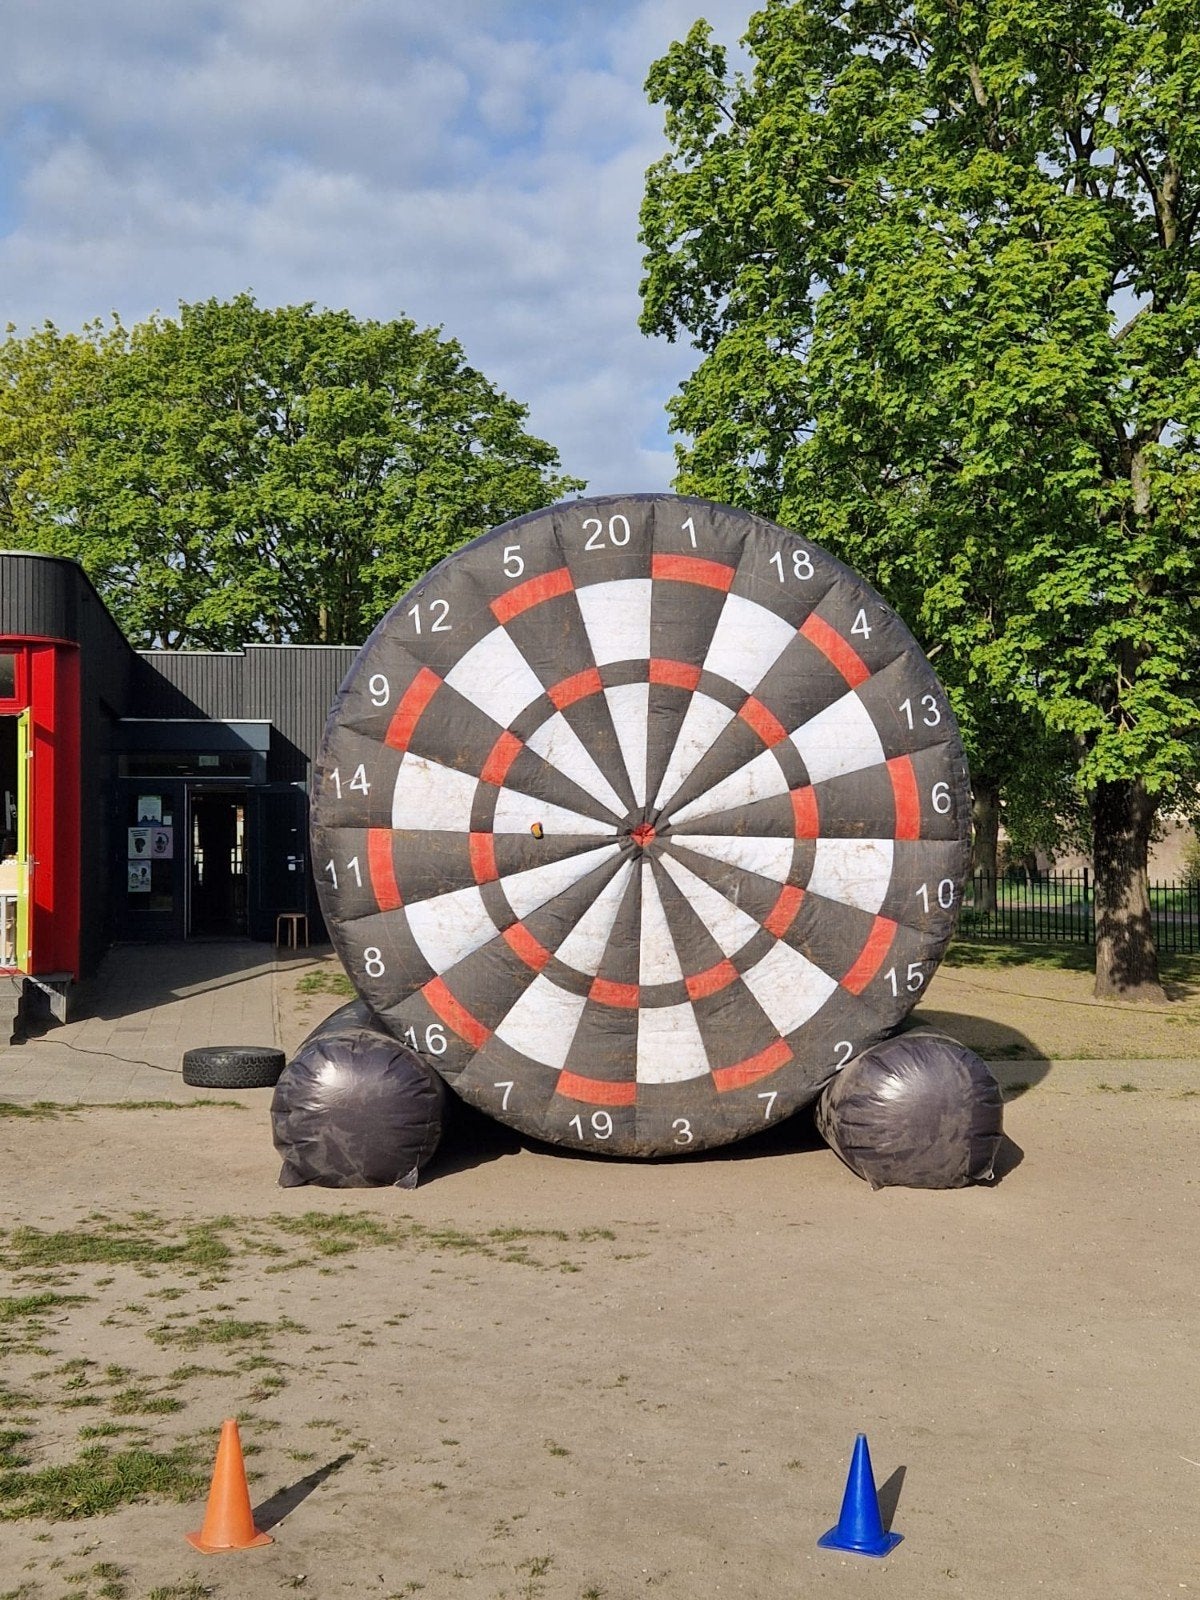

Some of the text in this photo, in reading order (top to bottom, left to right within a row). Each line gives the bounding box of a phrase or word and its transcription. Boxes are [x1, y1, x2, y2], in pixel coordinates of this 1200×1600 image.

[581, 513, 631, 552] 20
[680, 516, 698, 549] 1
[502, 543, 525, 579] 5
[768, 549, 815, 584] 18
[407, 598, 453, 635] 12
[850, 608, 873, 640] 4
[368, 673, 391, 707] 9
[898, 694, 941, 730] 13
[329, 763, 373, 800] 14
[931, 781, 951, 814] 6
[325, 856, 363, 890] 11
[915, 878, 955, 914] 10
[363, 946, 386, 978] 8
[883, 961, 924, 997] 15
[404, 1023, 448, 1055] 16
[833, 1040, 854, 1071] 2
[493, 1080, 515, 1111] 7
[757, 1090, 778, 1120] 7
[568, 1110, 613, 1140] 19
[671, 1117, 694, 1145] 3
